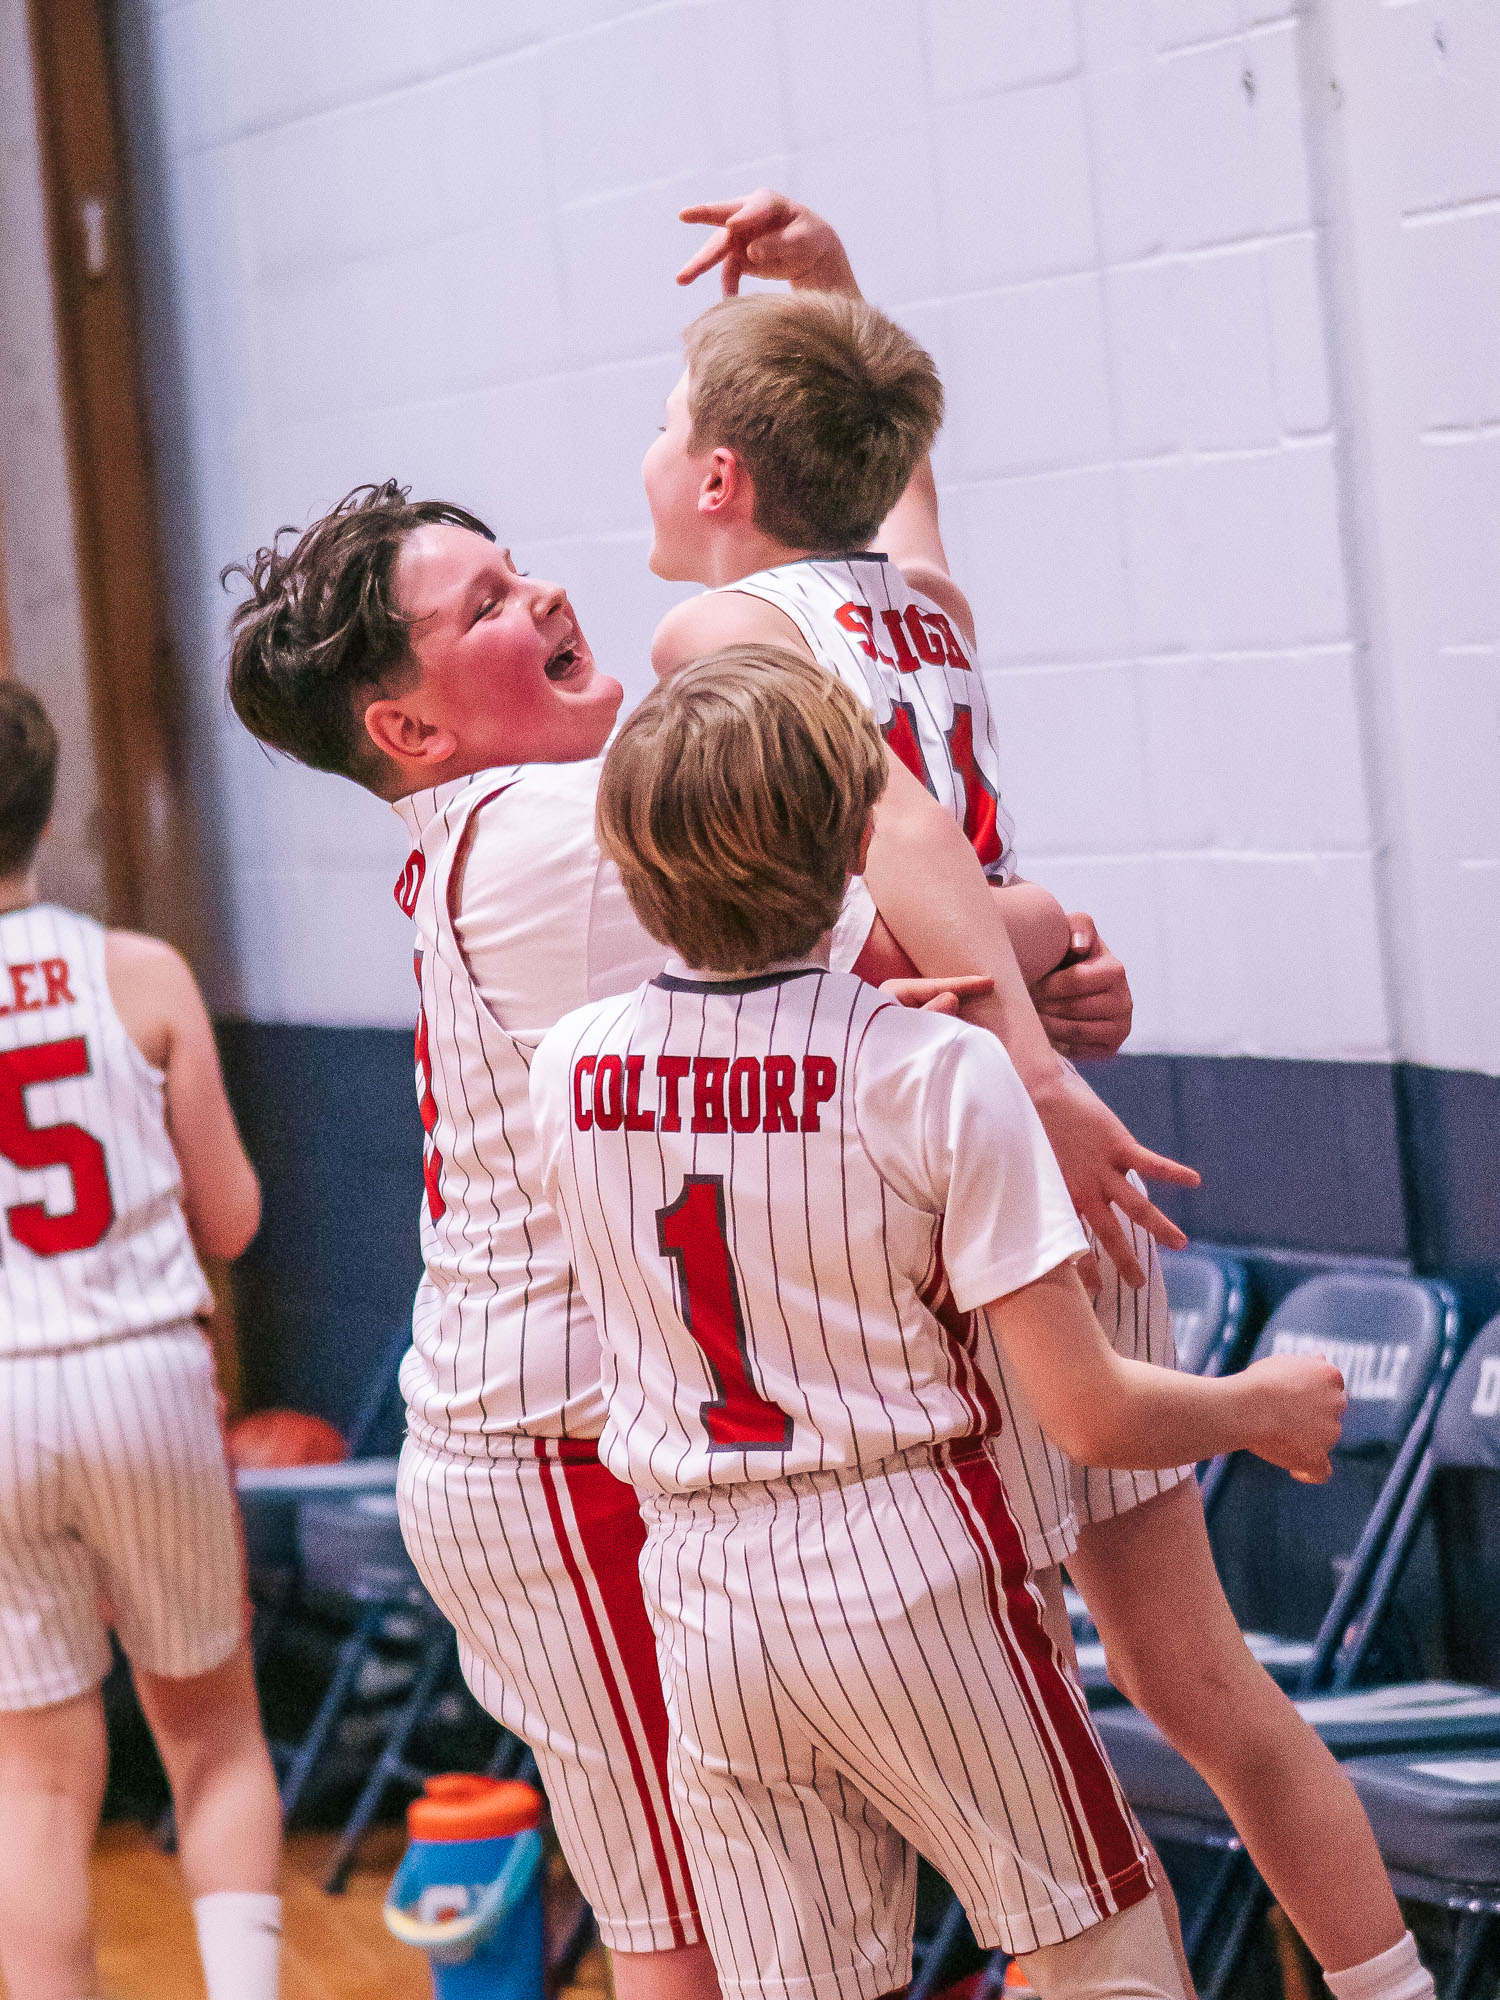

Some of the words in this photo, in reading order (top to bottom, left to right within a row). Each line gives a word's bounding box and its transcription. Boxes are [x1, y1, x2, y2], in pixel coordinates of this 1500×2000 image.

[0, 956, 77, 1017] ER
[573, 1054, 837, 1134] COLTHORP
[654, 1173, 795, 1454] 1
